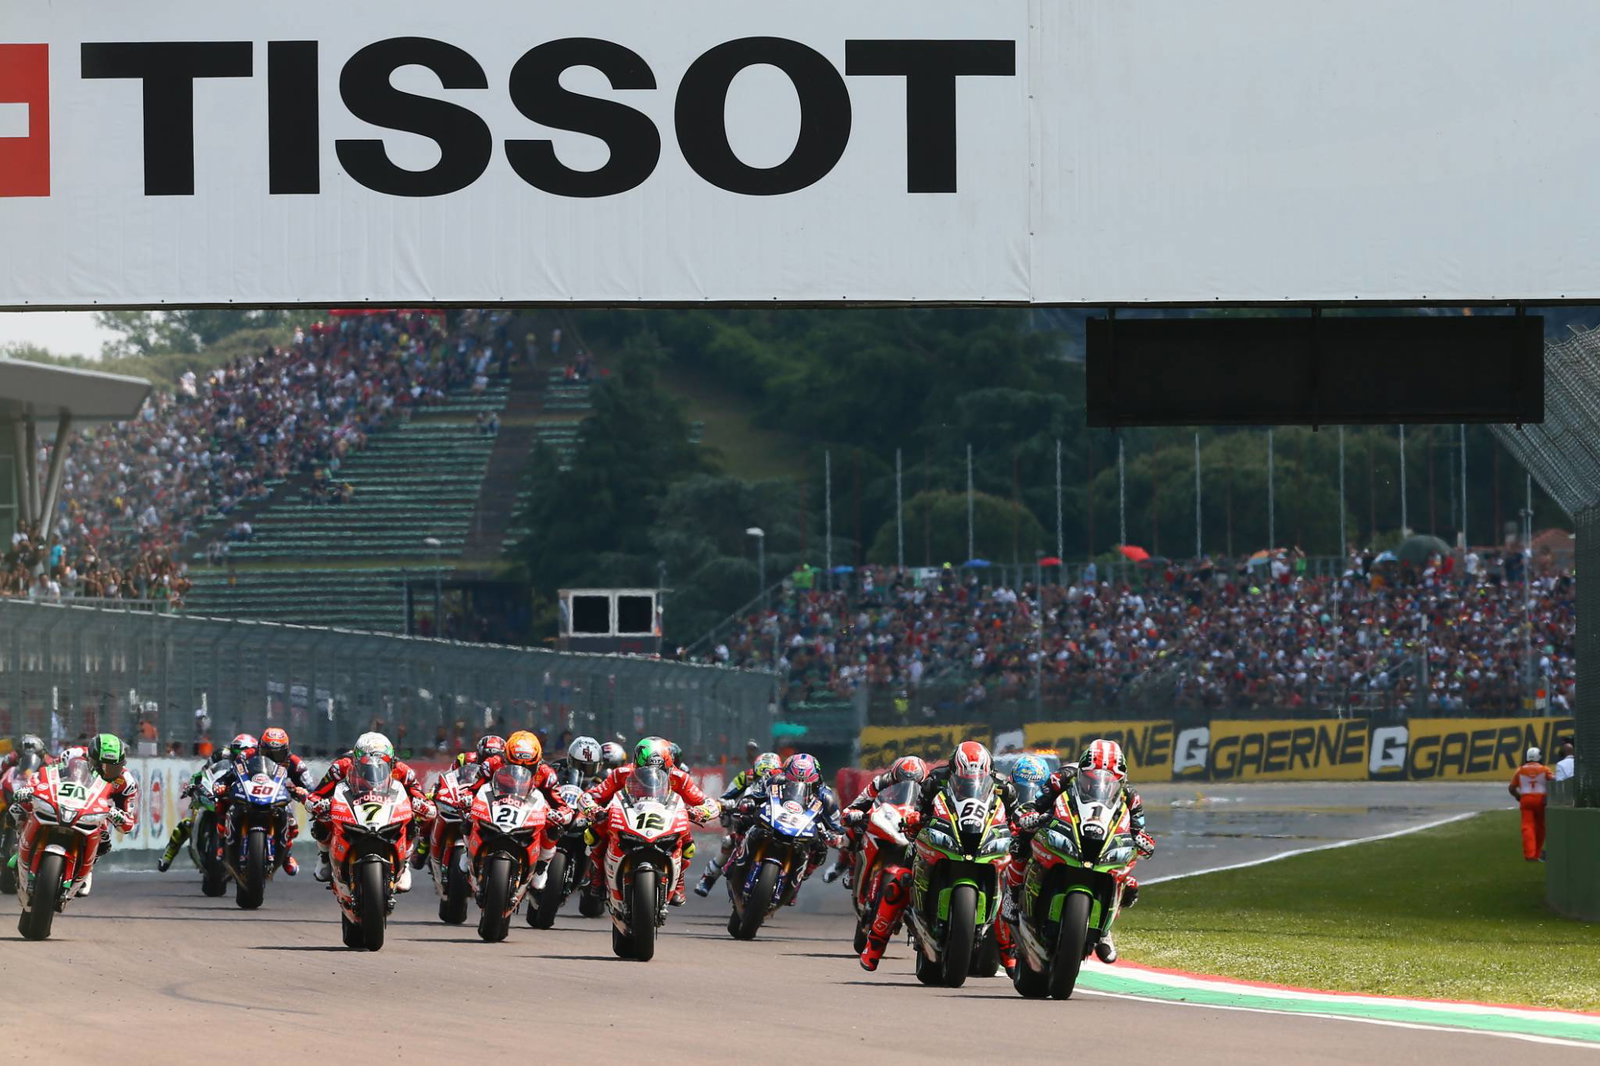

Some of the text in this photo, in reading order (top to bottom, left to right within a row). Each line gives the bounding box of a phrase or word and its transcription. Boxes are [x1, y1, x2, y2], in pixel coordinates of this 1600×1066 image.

[81, 36, 1016, 198] TISSOT
[1212, 719, 1369, 779] GAERNE
[58, 783, 87, 801] 50
[251, 785, 274, 796] 60
[363, 803, 382, 822] 7
[496, 807, 519, 825] 21
[961, 802, 986, 819] 66
[1086, 805, 1103, 821] 1
[635, 812, 665, 830] 12
